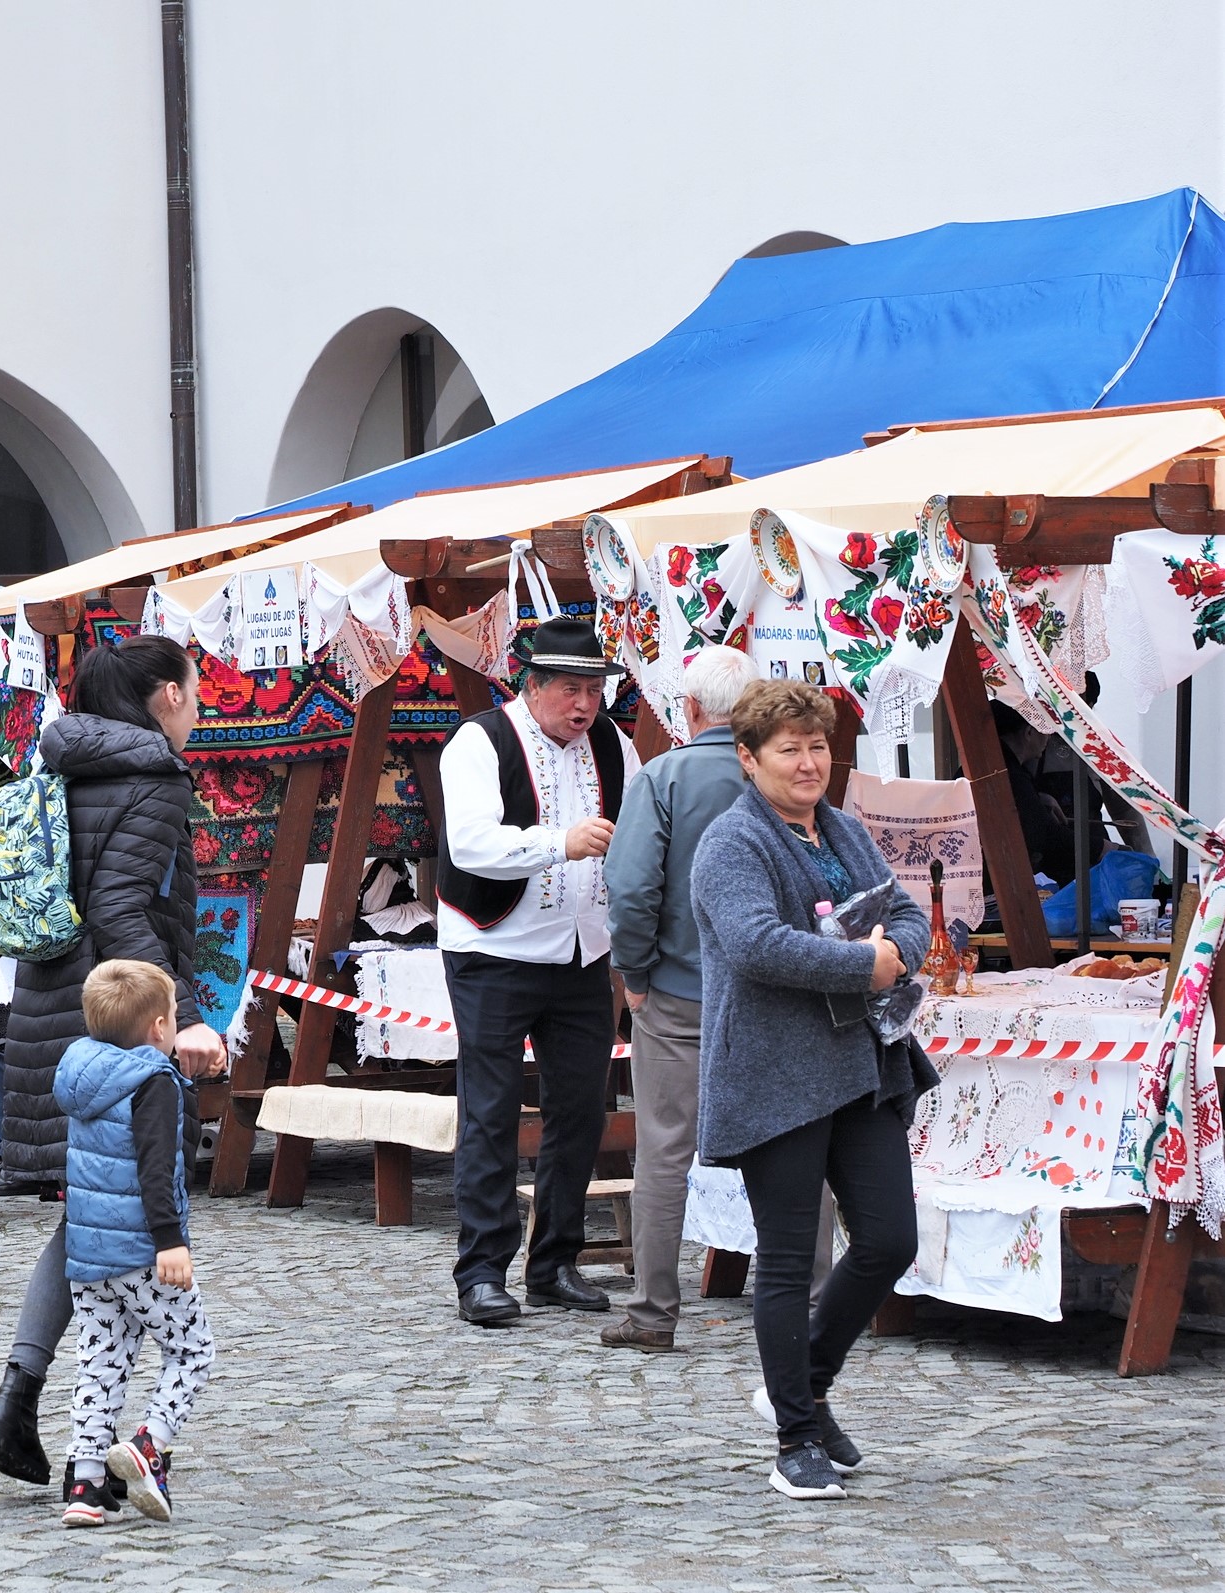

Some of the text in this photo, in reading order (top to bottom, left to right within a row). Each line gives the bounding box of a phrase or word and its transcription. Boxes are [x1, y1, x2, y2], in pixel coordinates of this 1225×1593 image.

[273, 610, 282, 622] DE
[282, 609, 296, 621] JOS
[18, 633, 35, 647] HUTA
[16, 648, 34, 662] HUTA
